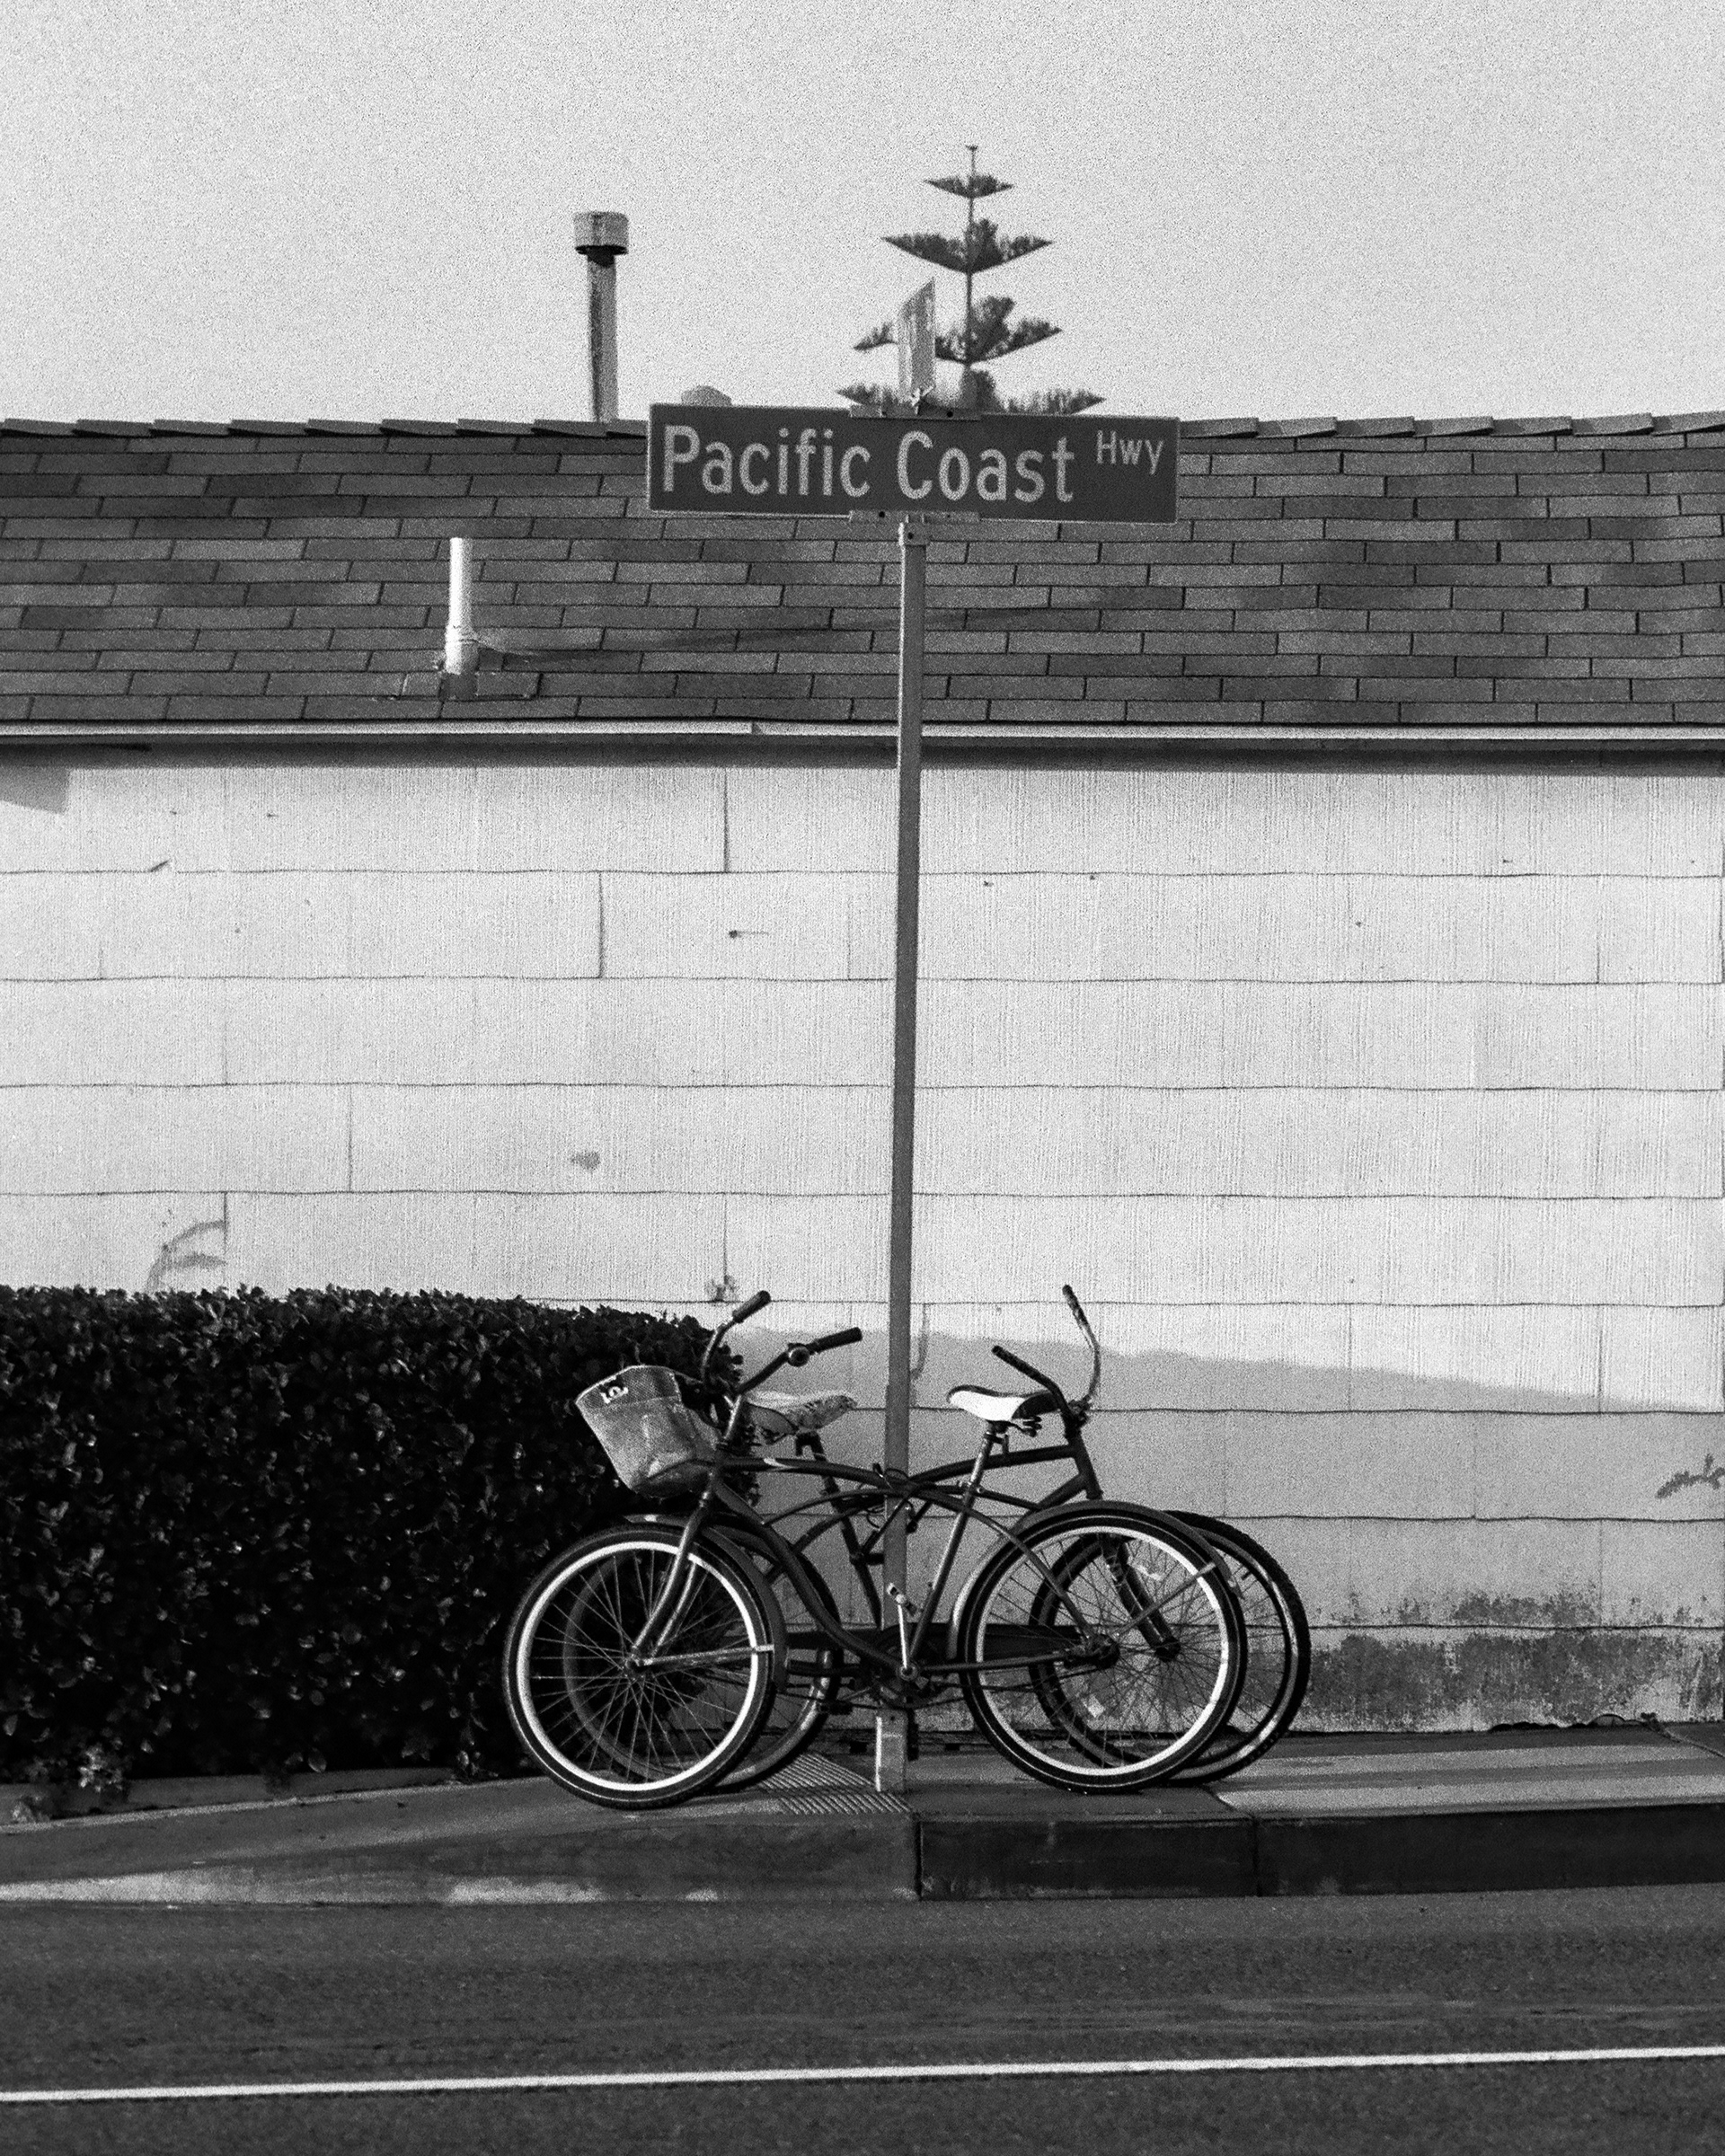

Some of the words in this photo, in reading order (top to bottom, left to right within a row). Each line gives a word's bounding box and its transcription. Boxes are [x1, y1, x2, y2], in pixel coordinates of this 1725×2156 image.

[663, 425, 871, 498] Pacific
[898, 430, 1075, 503] Coast
[1096, 429, 1164, 475] Hwy
